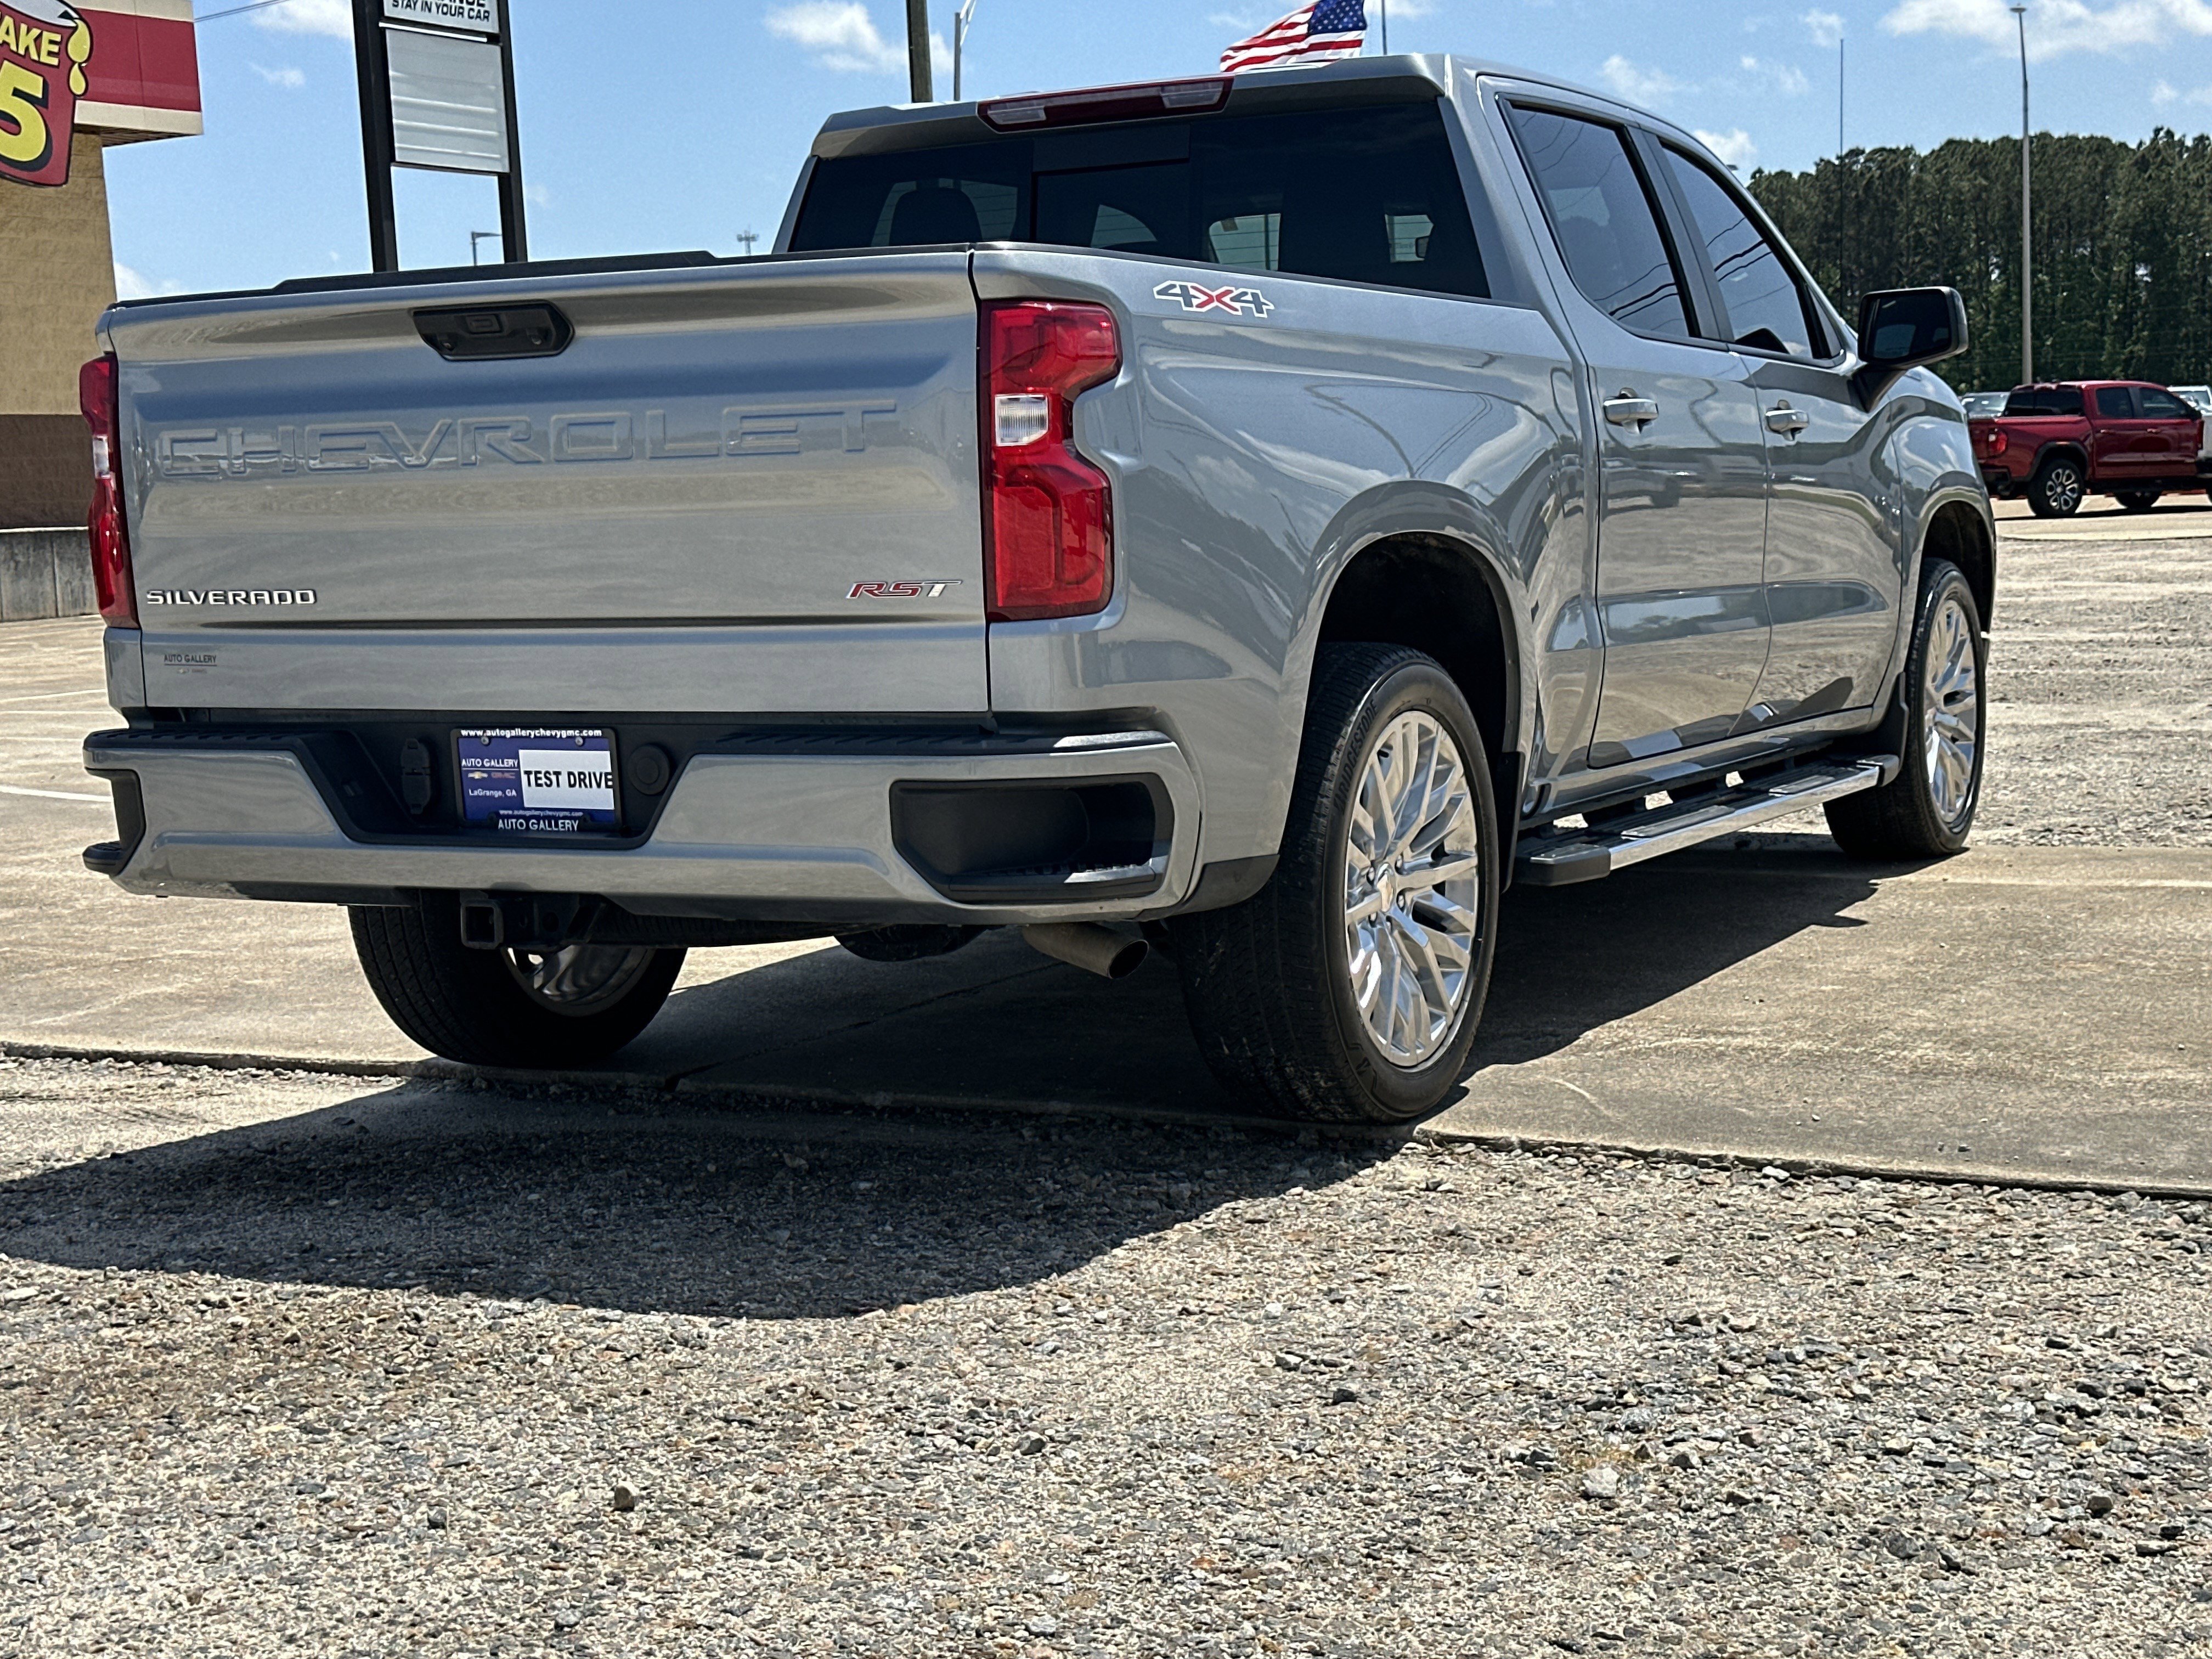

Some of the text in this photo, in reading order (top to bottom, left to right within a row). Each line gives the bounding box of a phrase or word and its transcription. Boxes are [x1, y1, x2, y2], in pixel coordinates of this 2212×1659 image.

[392, 0, 419, 11] STAY
[421, 0, 432, 14] IN
[435, 2, 465, 19] YOUR
[468, 7, 490, 22] CAR
[0, 14, 61, 66] AKE
[158, 399, 896, 476] CHEVROLET
[146, 589, 317, 606] SILVERADO
[846, 579, 962, 599] RST
[164, 654, 217, 663] AUTO GALLERY
[460, 728, 602, 738] www.autogallerychevygmc.com
[461, 758, 518, 768] AUTO GALLERY
[523, 770, 613, 789] TEST DRIVE
[498, 819, 579, 832] AUTO GALLERY
